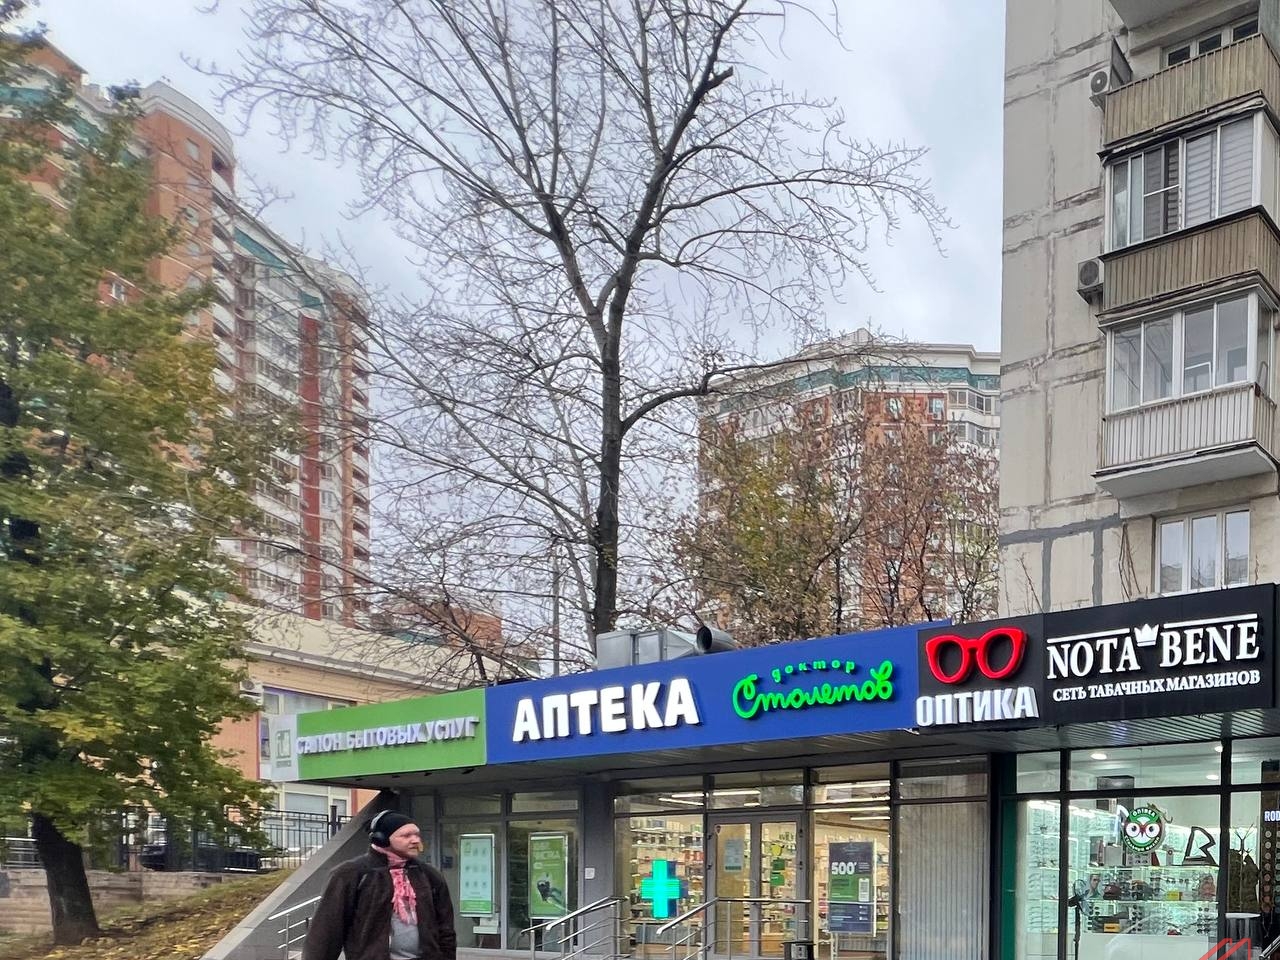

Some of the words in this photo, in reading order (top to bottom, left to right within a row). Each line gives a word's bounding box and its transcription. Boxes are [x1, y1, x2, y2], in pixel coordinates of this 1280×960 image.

[771, 658, 856, 683] доктор
[1047, 637, 1141, 679] NOTA
[1159, 621, 1260, 668] BENE
[732, 660, 894, 719] Столетов
[1053, 687, 1087, 702] СЕТЬ
[1088, 680, 1164, 699] ТАБАЧНЫХ
[1164, 669, 1261, 692] МАГАЗИНОВ
[512, 677, 700, 742] АПТЕКА
[916, 686, 1039, 727] ОПТИКА
[347, 722, 426, 751] БЫТОВЫХ
[425, 716, 479, 742] УСЛУГ
